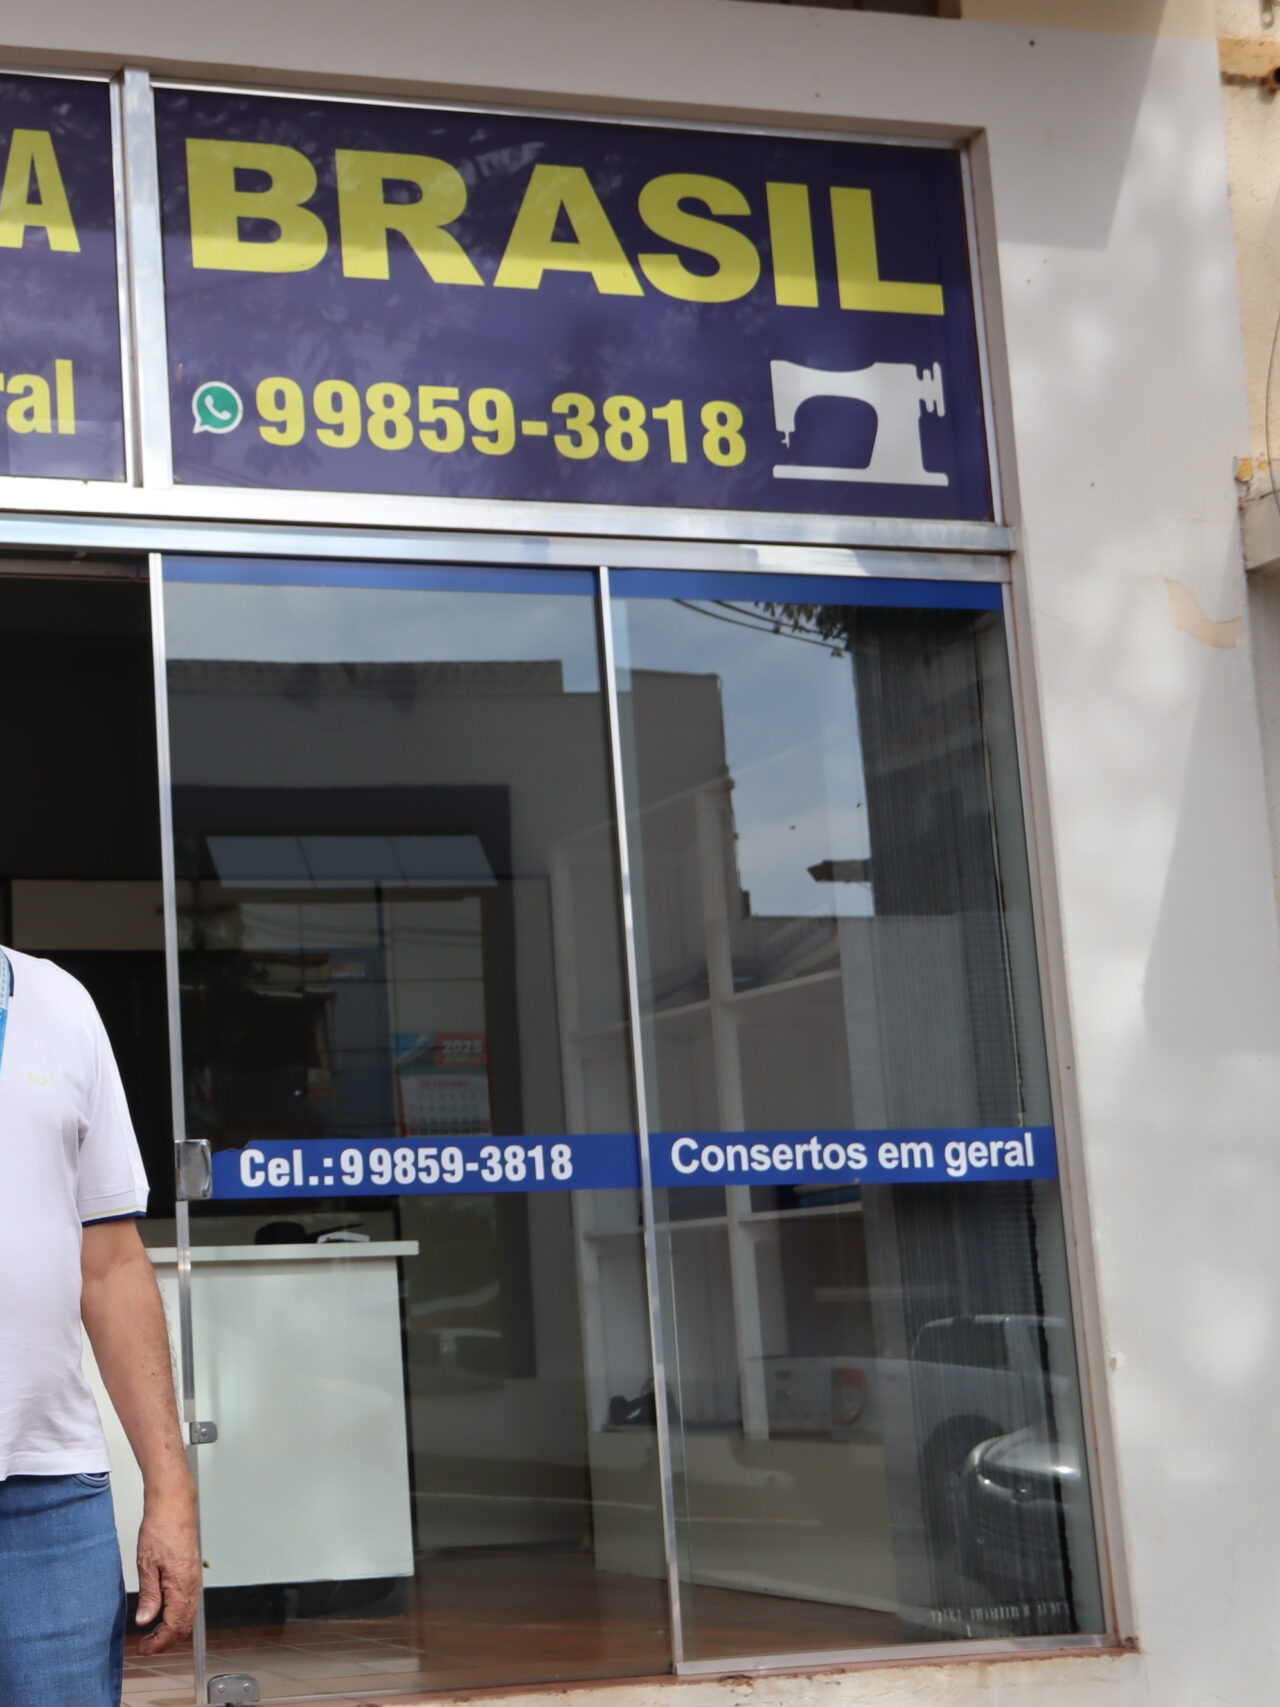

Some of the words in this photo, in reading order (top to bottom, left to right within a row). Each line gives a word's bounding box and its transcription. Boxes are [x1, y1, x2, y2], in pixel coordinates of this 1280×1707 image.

[186, 138, 944, 315] BRASIL
[256, 376, 747, 467] 99859-3818
[671, 1135, 868, 1174] Consertos
[878, 1141, 934, 1169] em
[944, 1132, 1035, 1177] geral
